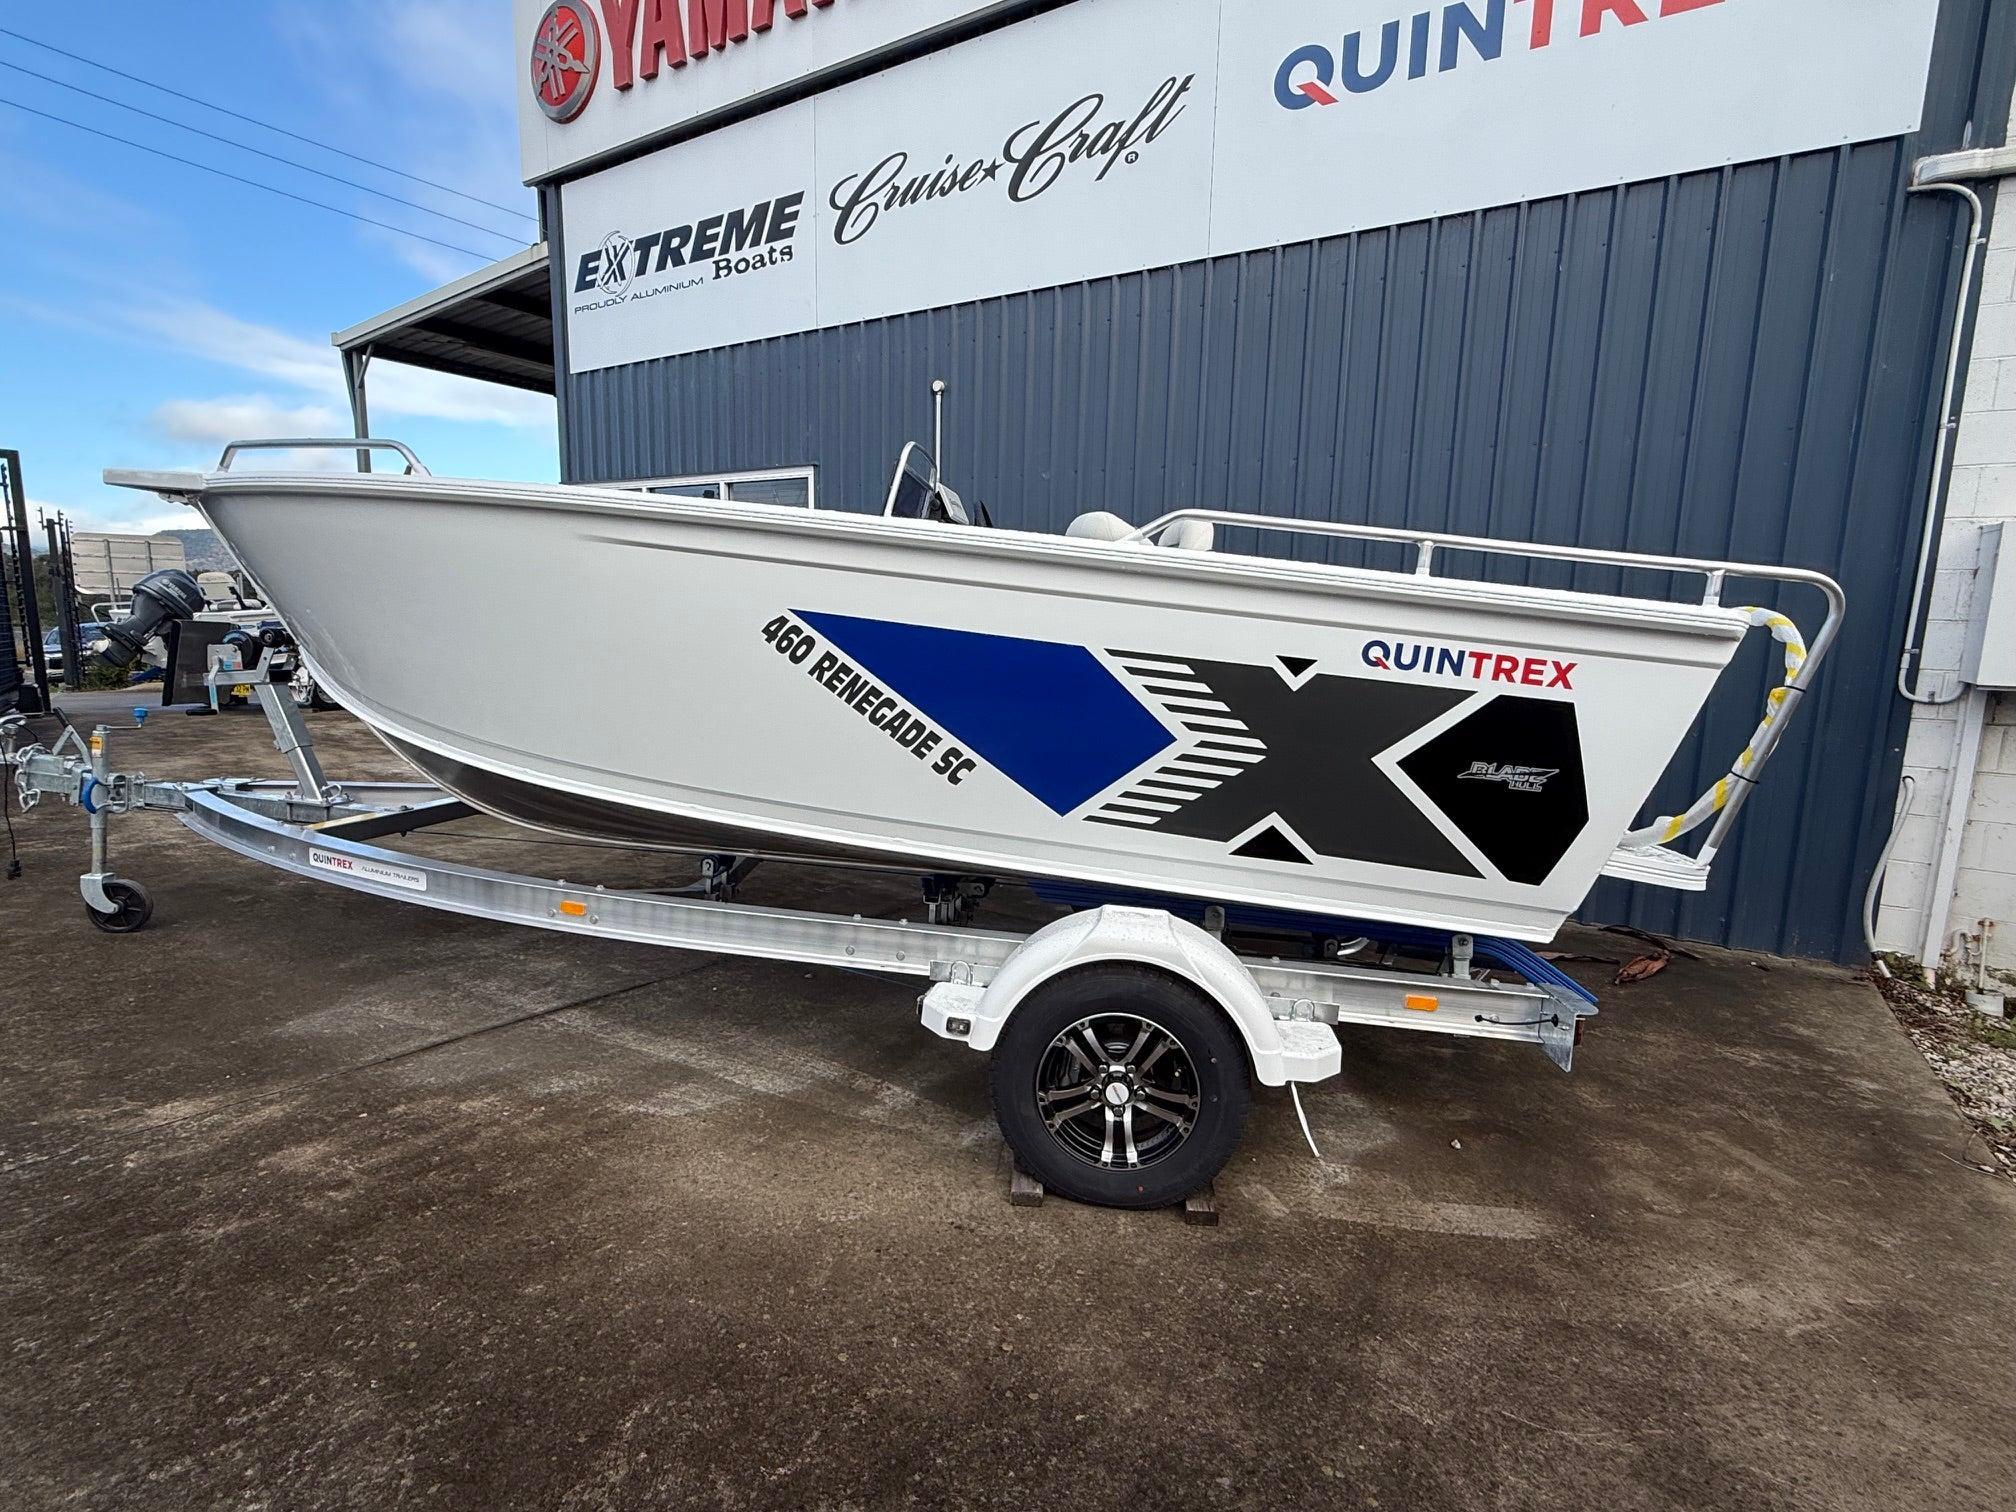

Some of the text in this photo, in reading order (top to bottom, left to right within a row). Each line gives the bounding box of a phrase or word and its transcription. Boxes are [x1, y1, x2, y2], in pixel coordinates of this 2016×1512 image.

[829, 73, 1195, 245] Cruise Craft
[574, 190, 805, 294] EXTREME
[712, 244, 794, 281] Boats
[574, 276, 705, 315] PROUDLY ALUMINIUM
[1361, 639, 1578, 690] QUINTREX
[761, 614, 978, 786] 460 RENEGADE SC
[1464, 761, 1557, 782] BLADE
[312, 853, 354, 870] QUINTREX
